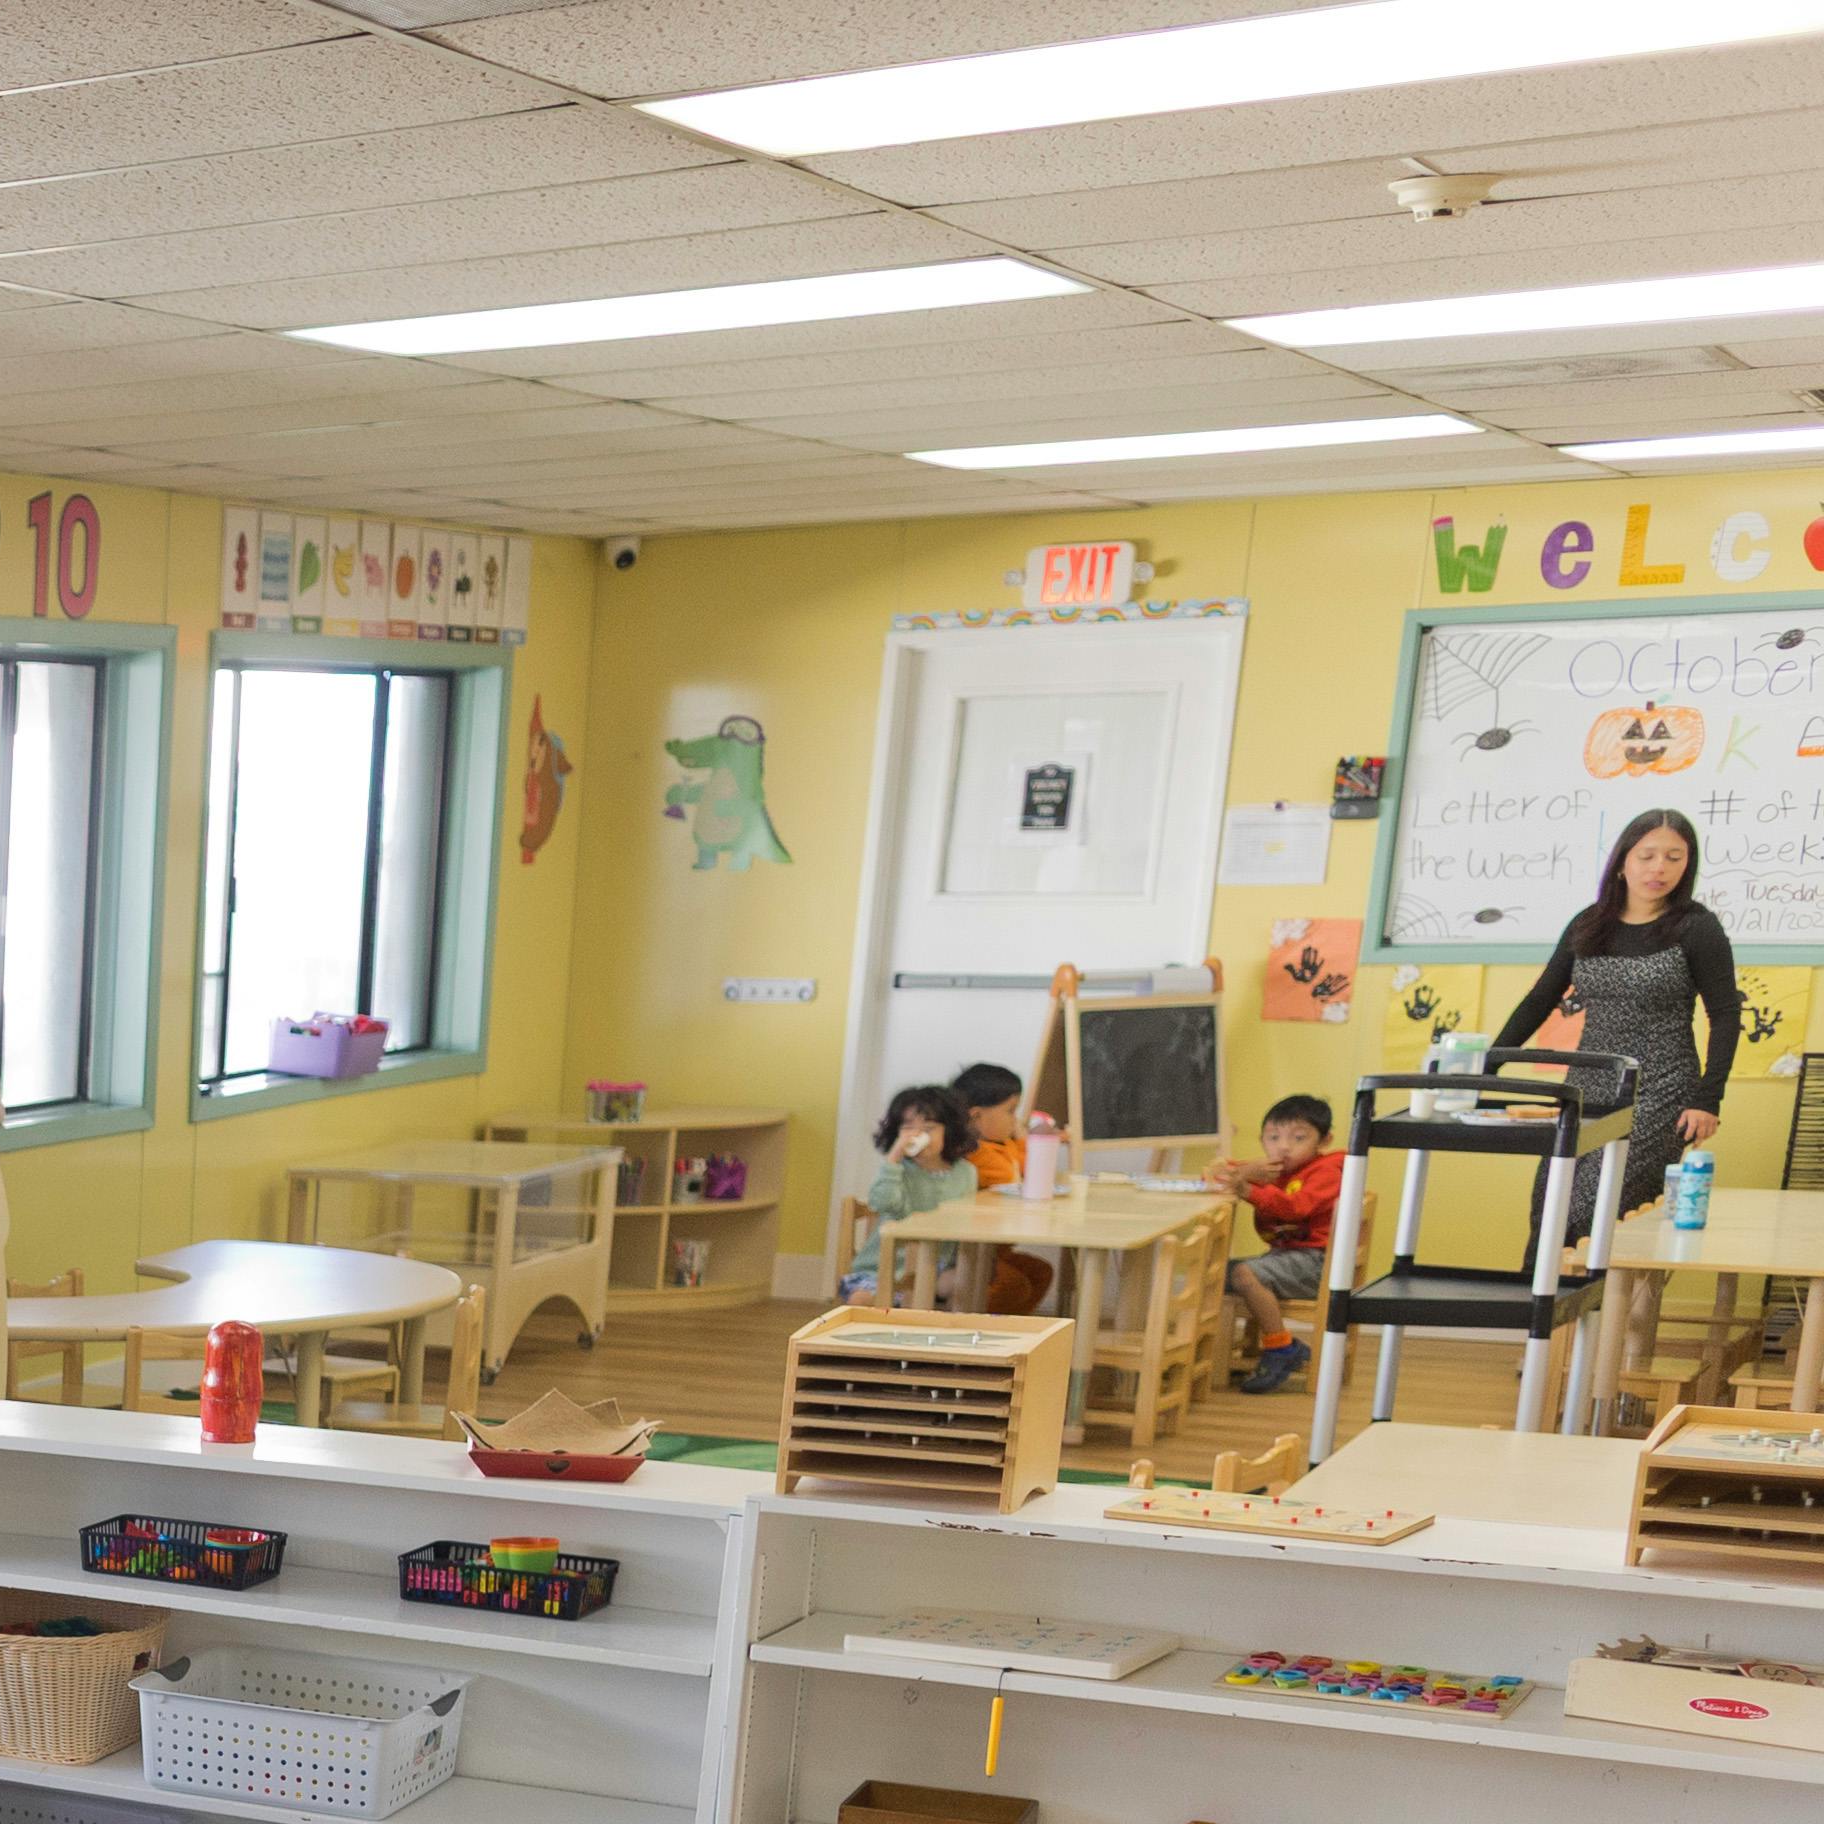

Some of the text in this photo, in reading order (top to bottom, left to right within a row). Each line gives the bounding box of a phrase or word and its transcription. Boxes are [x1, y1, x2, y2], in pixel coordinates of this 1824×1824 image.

[27, 490, 101, 620] 10
[1041, 545, 1120, 604] EXIT
[1546, 788, 1592, 820] of
[1757, 790, 1797, 822] of
